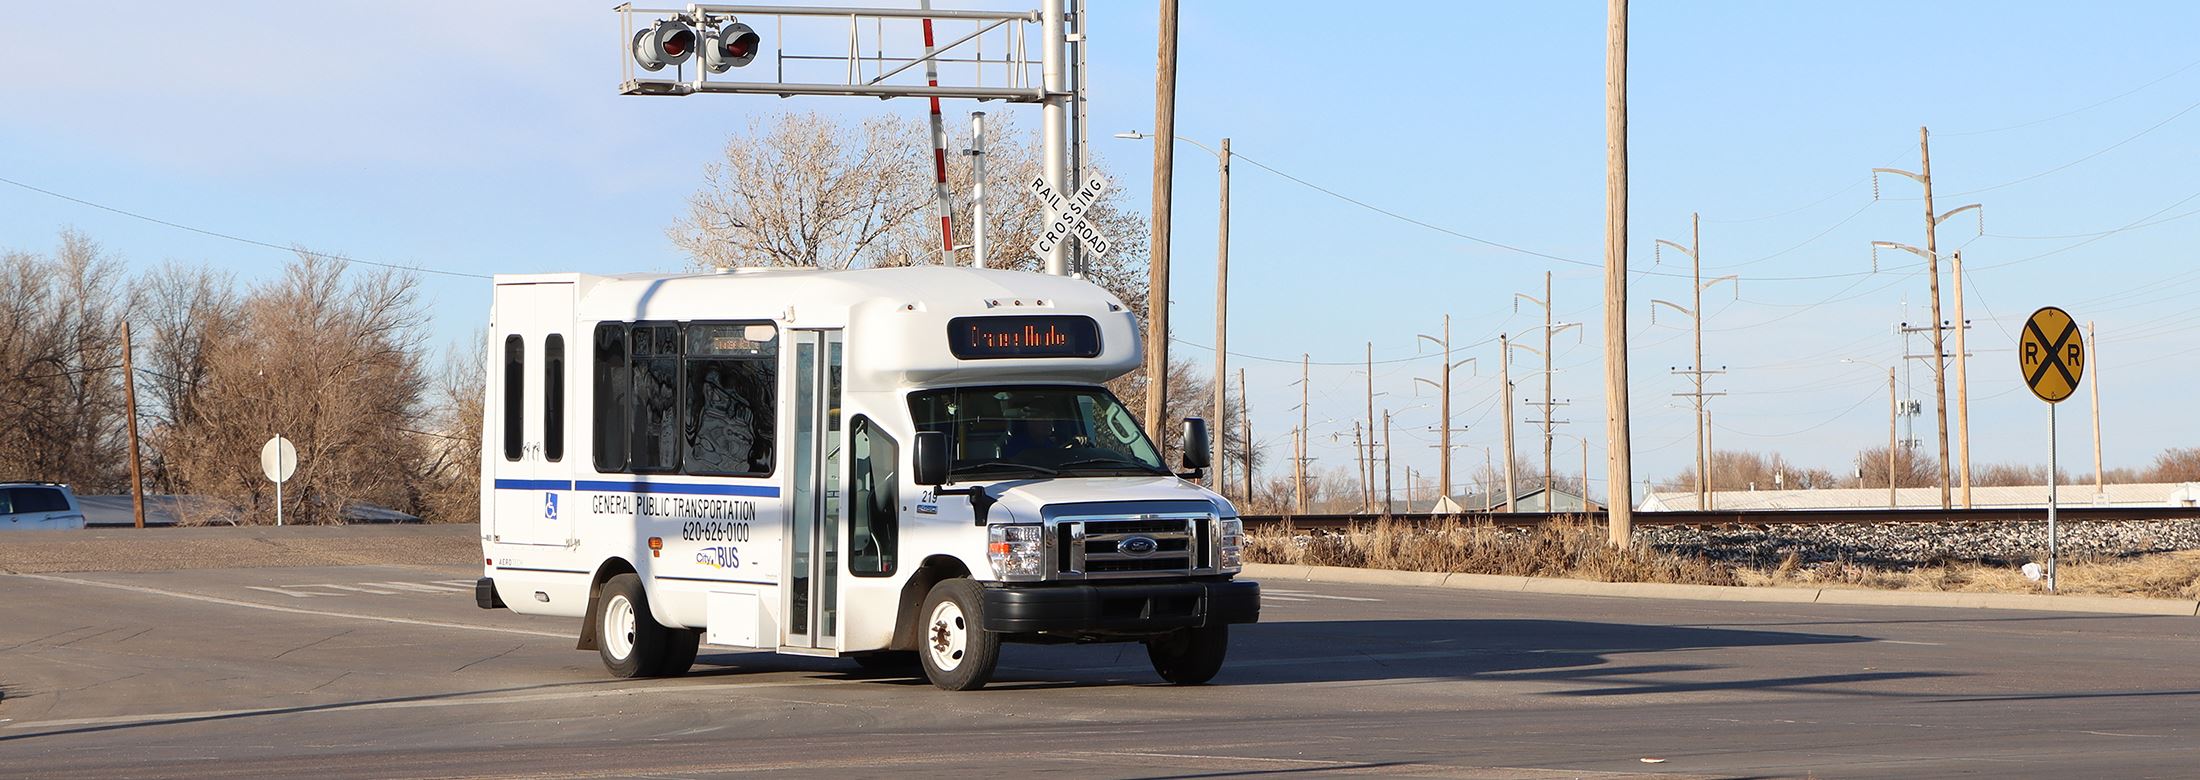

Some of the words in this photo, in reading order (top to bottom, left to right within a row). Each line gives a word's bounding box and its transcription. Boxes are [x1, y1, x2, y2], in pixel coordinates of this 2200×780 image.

[1031, 177, 1060, 211] RAIL
[1039, 179, 1101, 252] CROSSING
[1074, 220, 1107, 253] ROAD
[2025, 342, 2038, 364] R
[2067, 344, 2080, 366] R
[592, 495, 633, 515] GENERAL
[636, 496, 670, 517] PUBLIC
[673, 498, 756, 521] TRANSPORTATION
[682, 521, 750, 543] 620-626-0100
[718, 546, 740, 569] BUS
